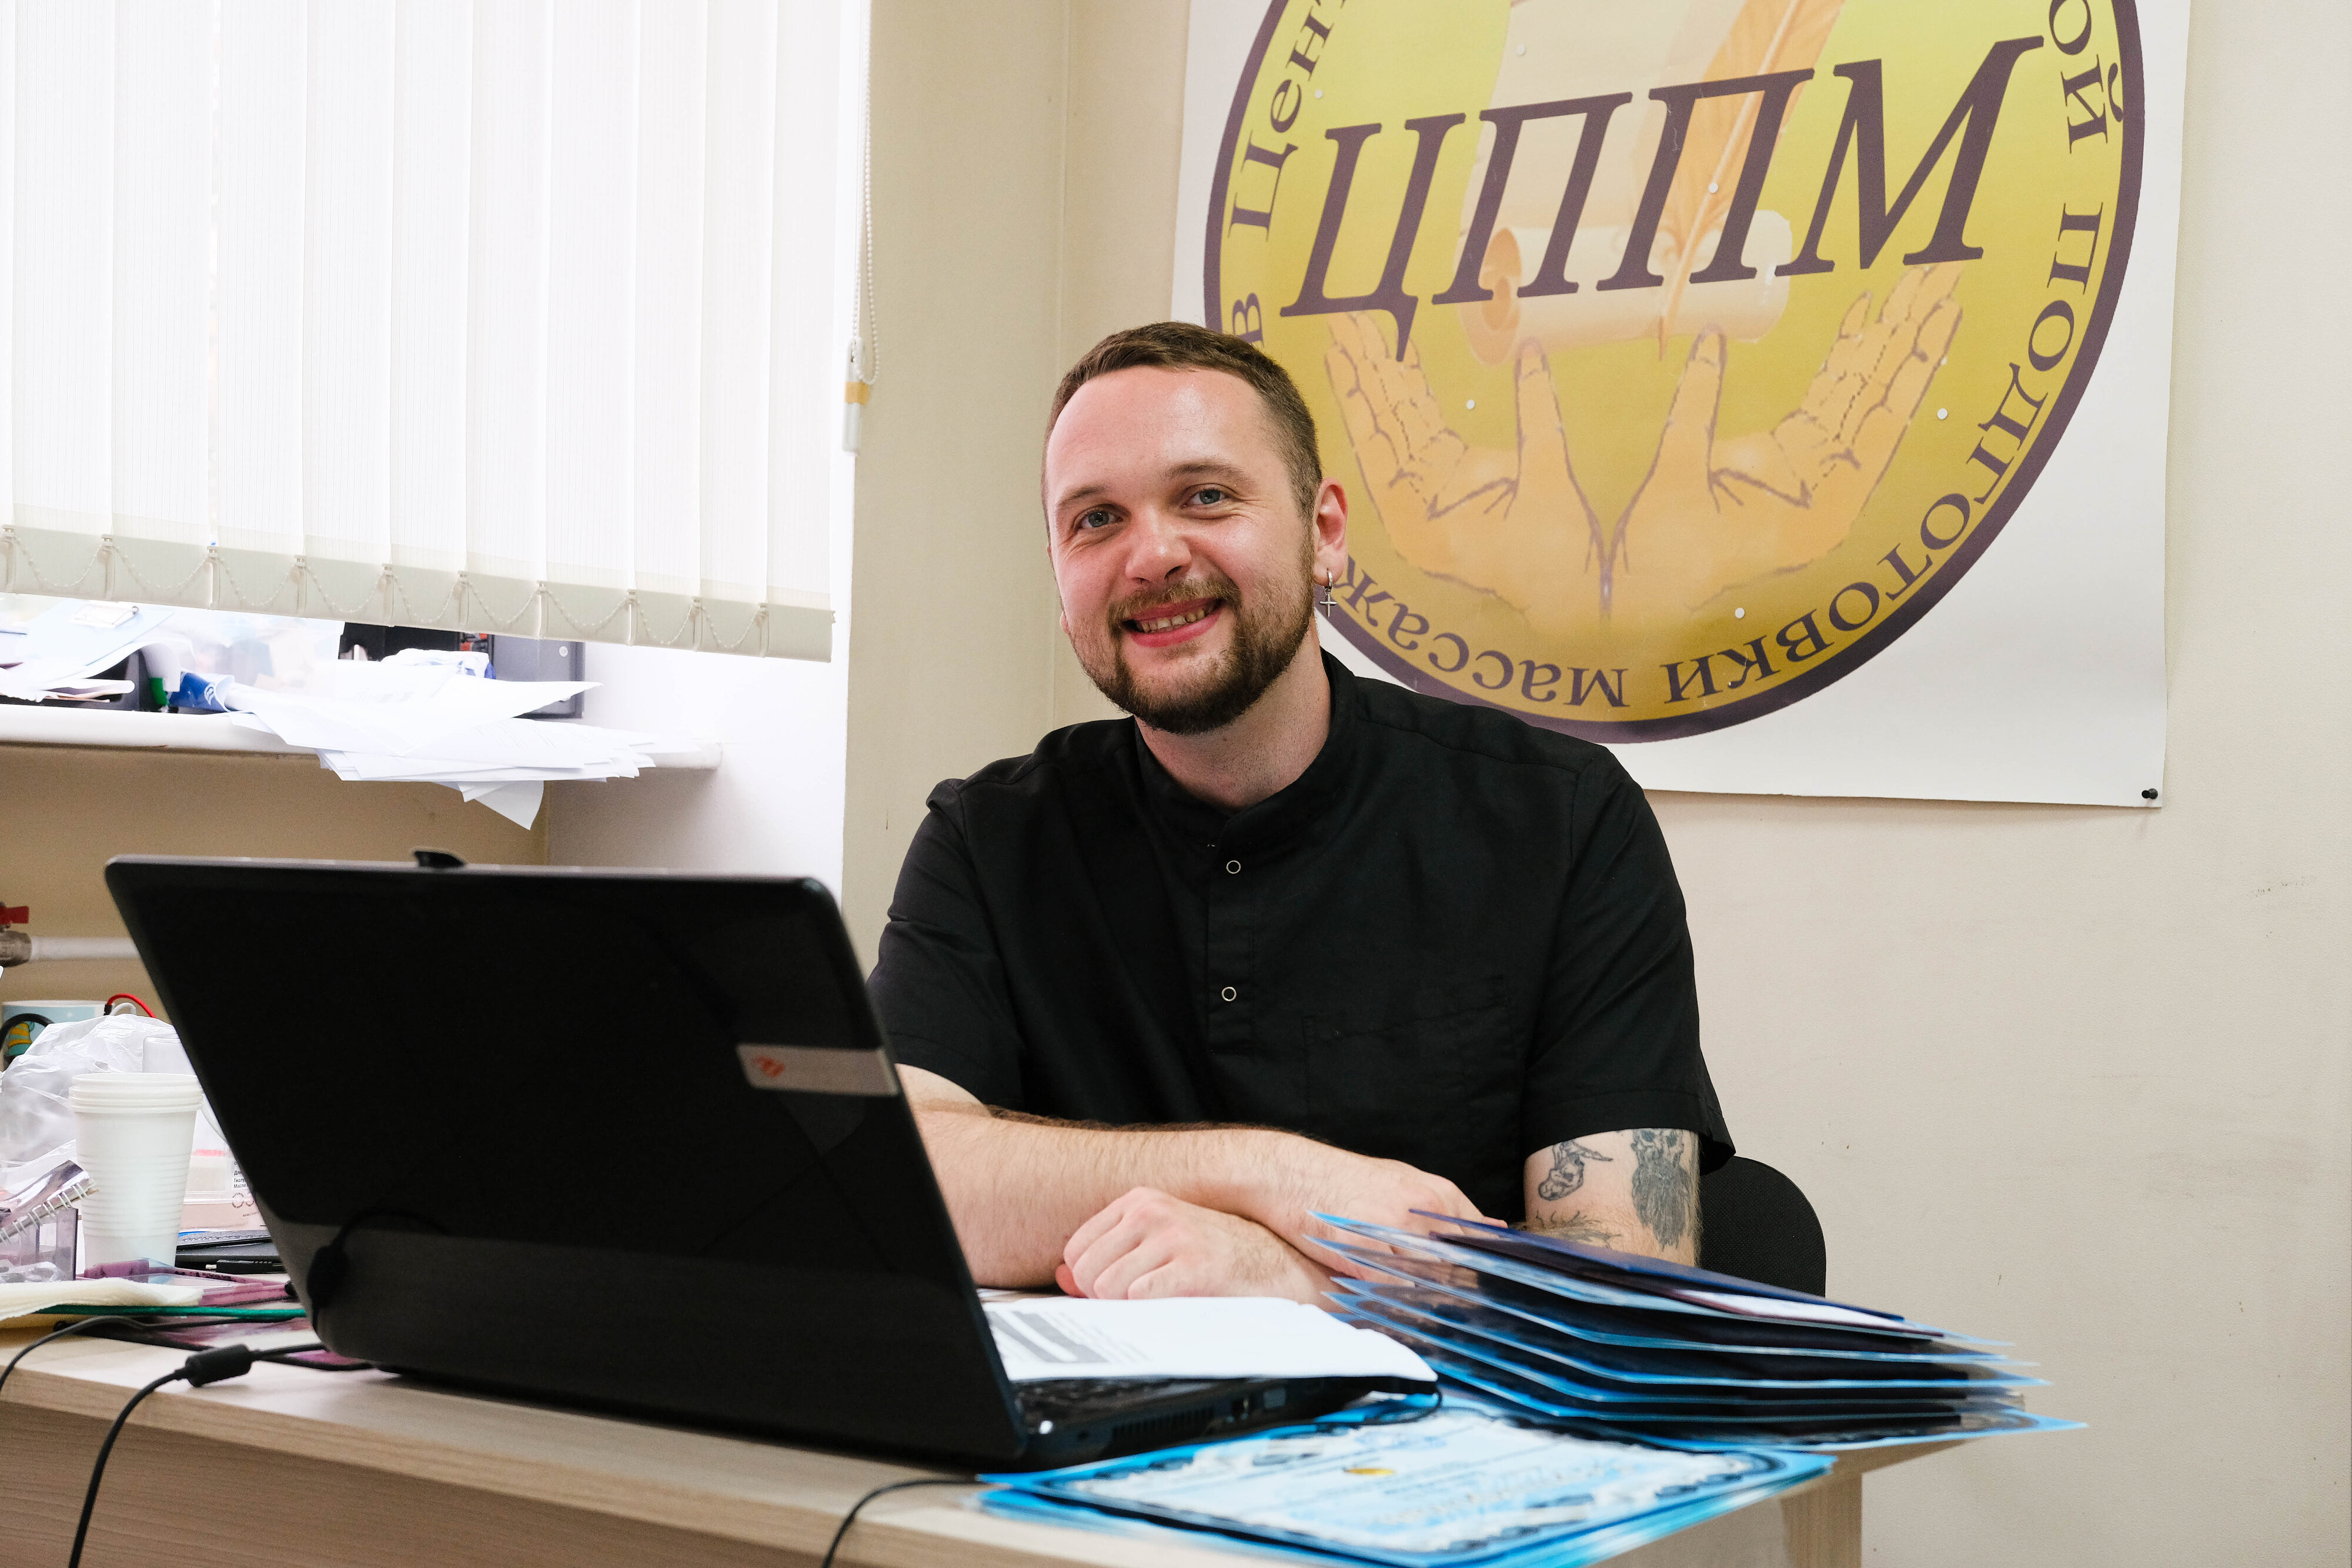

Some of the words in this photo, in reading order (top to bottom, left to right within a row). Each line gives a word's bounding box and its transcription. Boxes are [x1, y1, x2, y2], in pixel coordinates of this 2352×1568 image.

[1228, 0, 1345, 241] Цен
[1661, 202, 2103, 704] подготовки
[1279, 35, 2044, 362] ЦППМ
